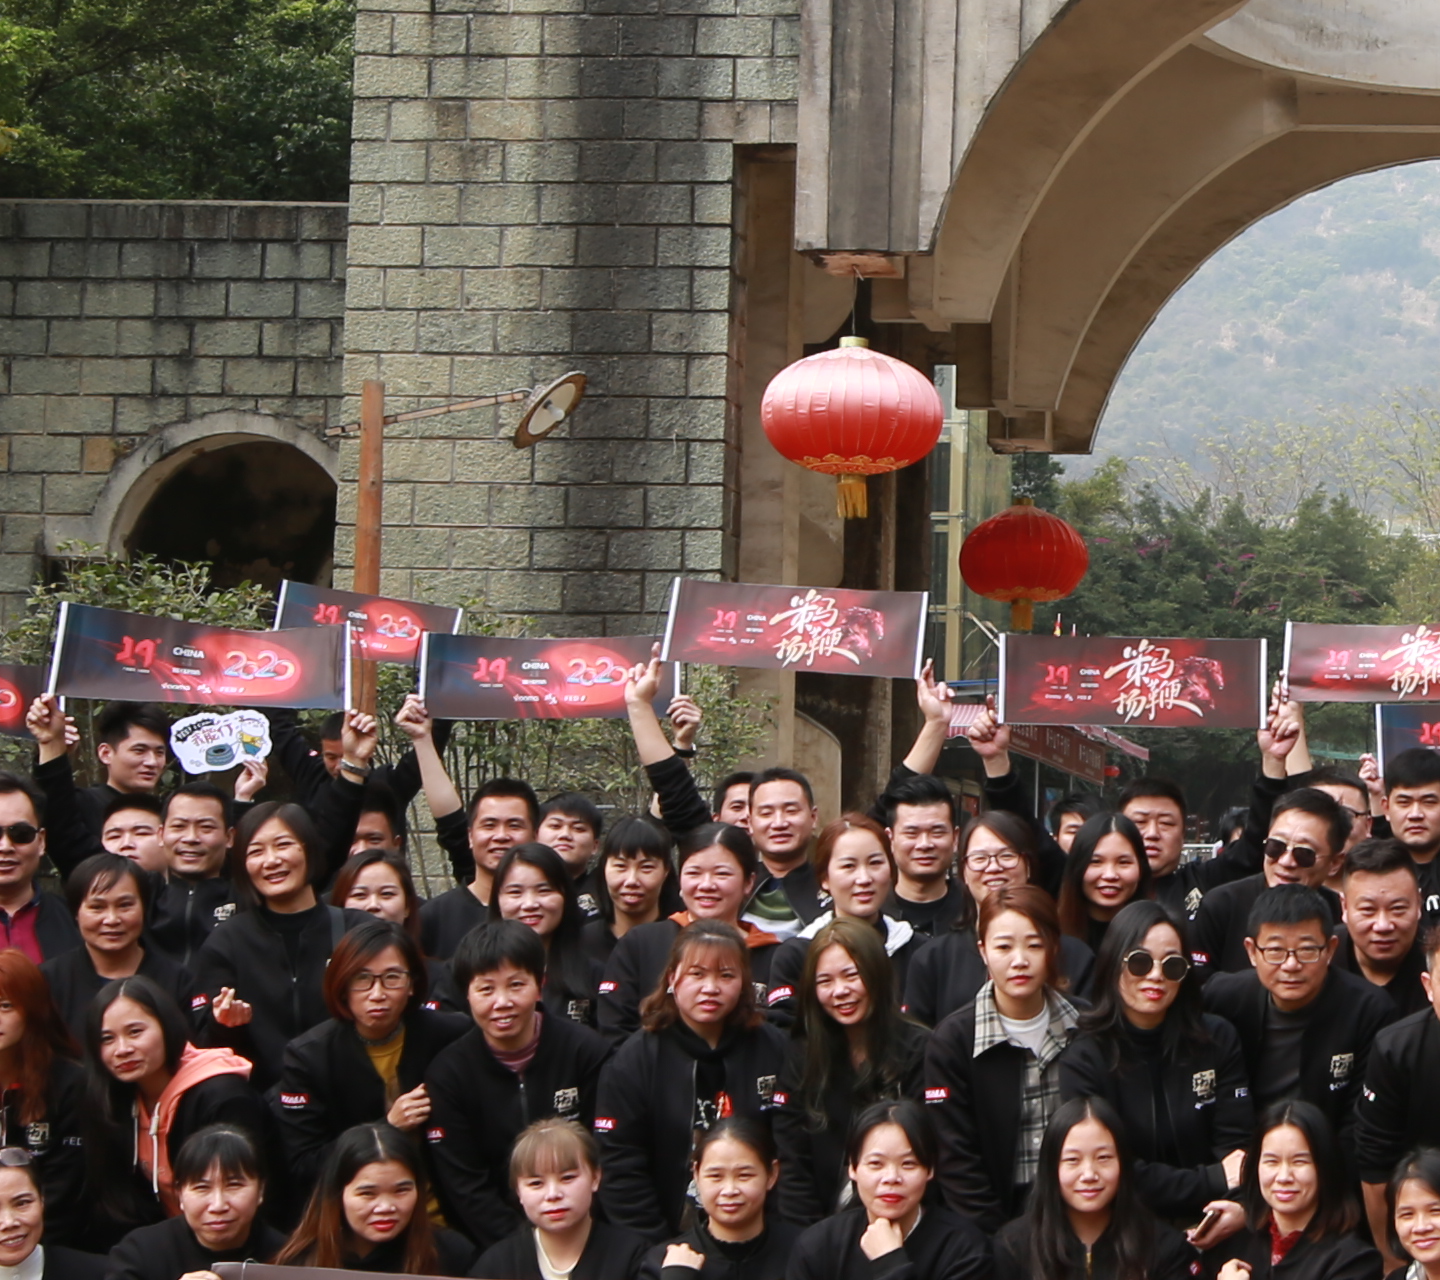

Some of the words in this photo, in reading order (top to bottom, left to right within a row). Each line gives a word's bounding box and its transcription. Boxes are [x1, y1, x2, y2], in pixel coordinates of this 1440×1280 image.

[377, 614, 421, 641] 2020
[224, 650, 296, 682] 2020
[567, 656, 628, 686] 2020
